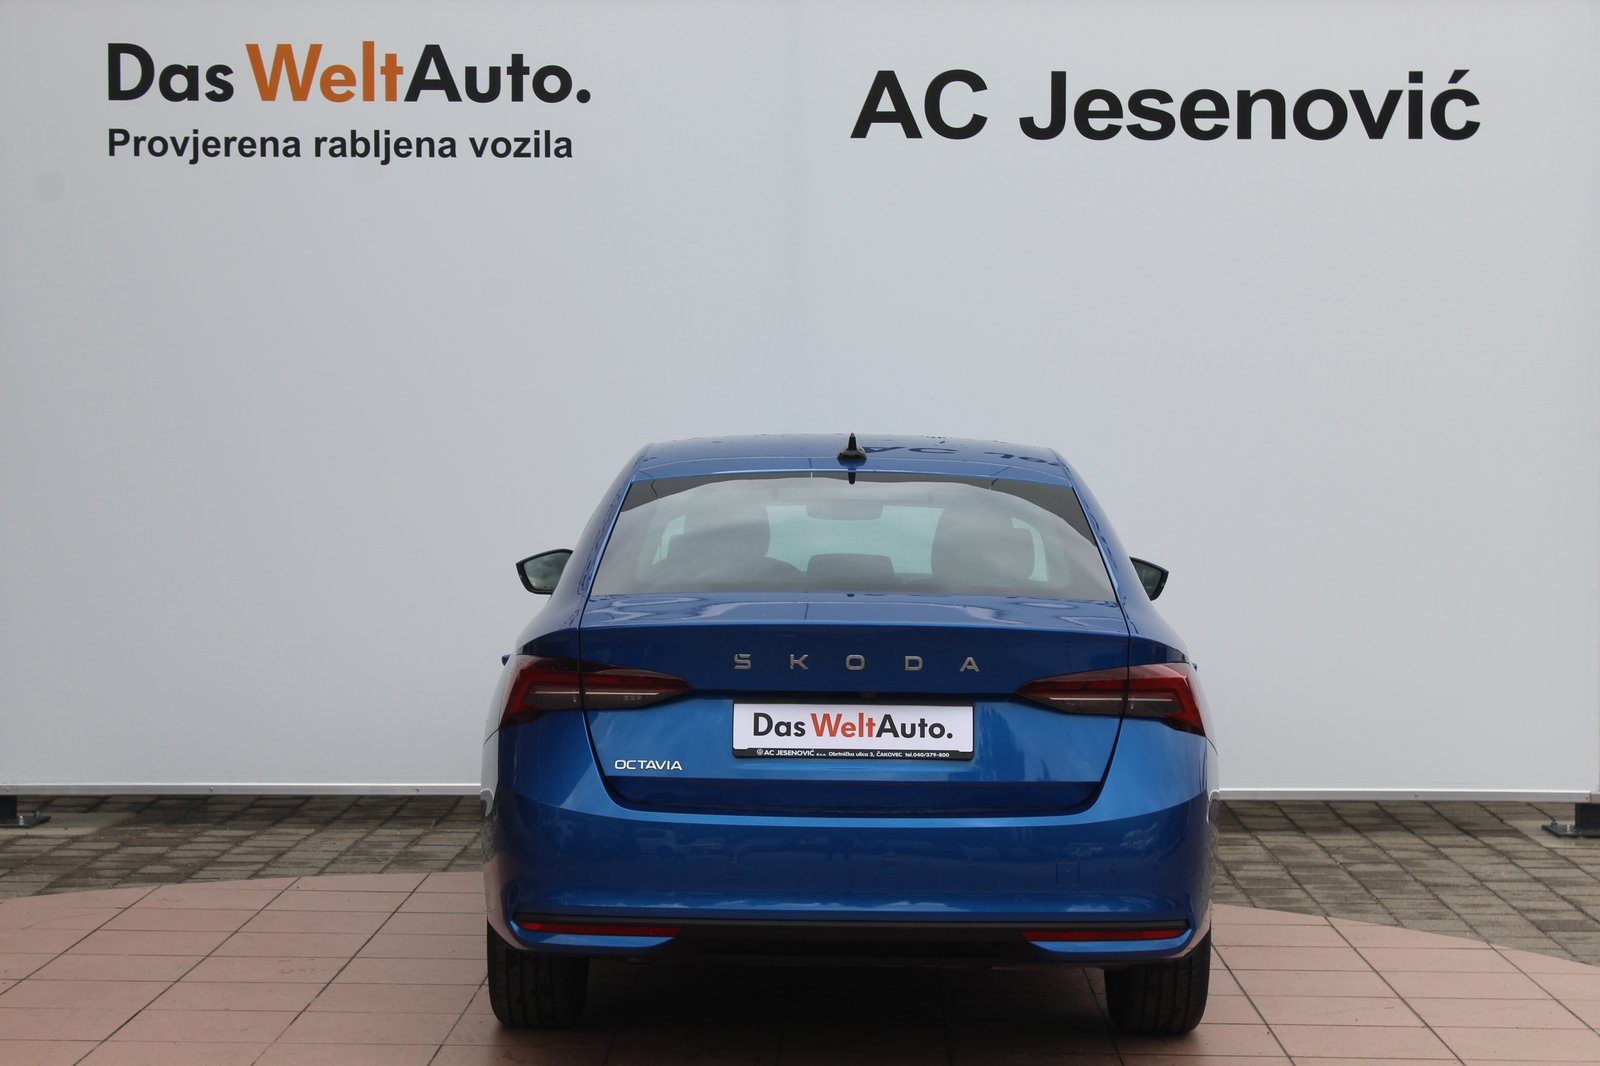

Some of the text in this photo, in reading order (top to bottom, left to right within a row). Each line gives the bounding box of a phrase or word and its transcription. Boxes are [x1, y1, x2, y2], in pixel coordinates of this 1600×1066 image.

[107, 40, 592, 104] Das WeltAuto.
[850, 68, 1481, 142] AC Jesenović
[108, 128, 574, 166] Provjerena rabljena vozila
[753, 712, 954, 740] Das WeltAuto.
[614, 759, 683, 771] OCTAVIA
[776, 748, 815, 756] JESENOVIĆ
[876, 750, 903, 758] ČAKOVEC
